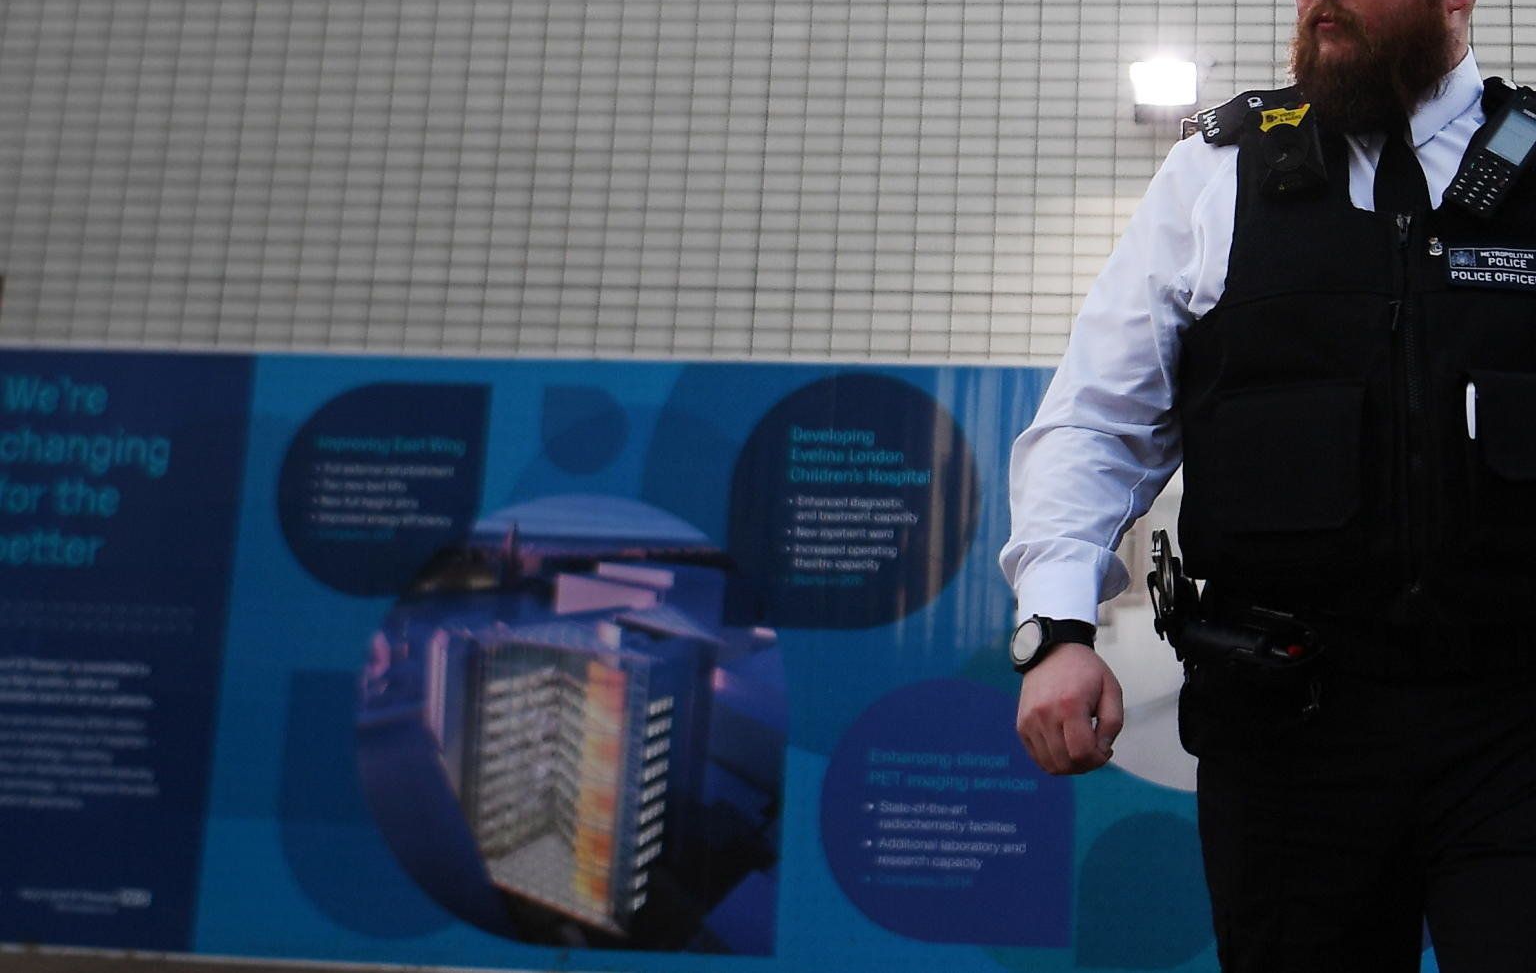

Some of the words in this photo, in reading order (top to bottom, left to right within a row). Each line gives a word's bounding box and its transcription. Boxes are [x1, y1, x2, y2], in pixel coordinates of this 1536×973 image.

[1203, 110, 1220, 137] 1448
[1480, 251, 1534, 259] METROPOLITAN
[1488, 257, 1527, 268] POLICE
[1451, 271, 1492, 281] POLICE
[4, 376, 108, 414] We're
[792, 425, 875, 447] Developing
[0, 427, 171, 478] changing
[849, 448, 904, 464] London
[867, 468, 932, 486] Hospital
[54, 478, 121, 517] the
